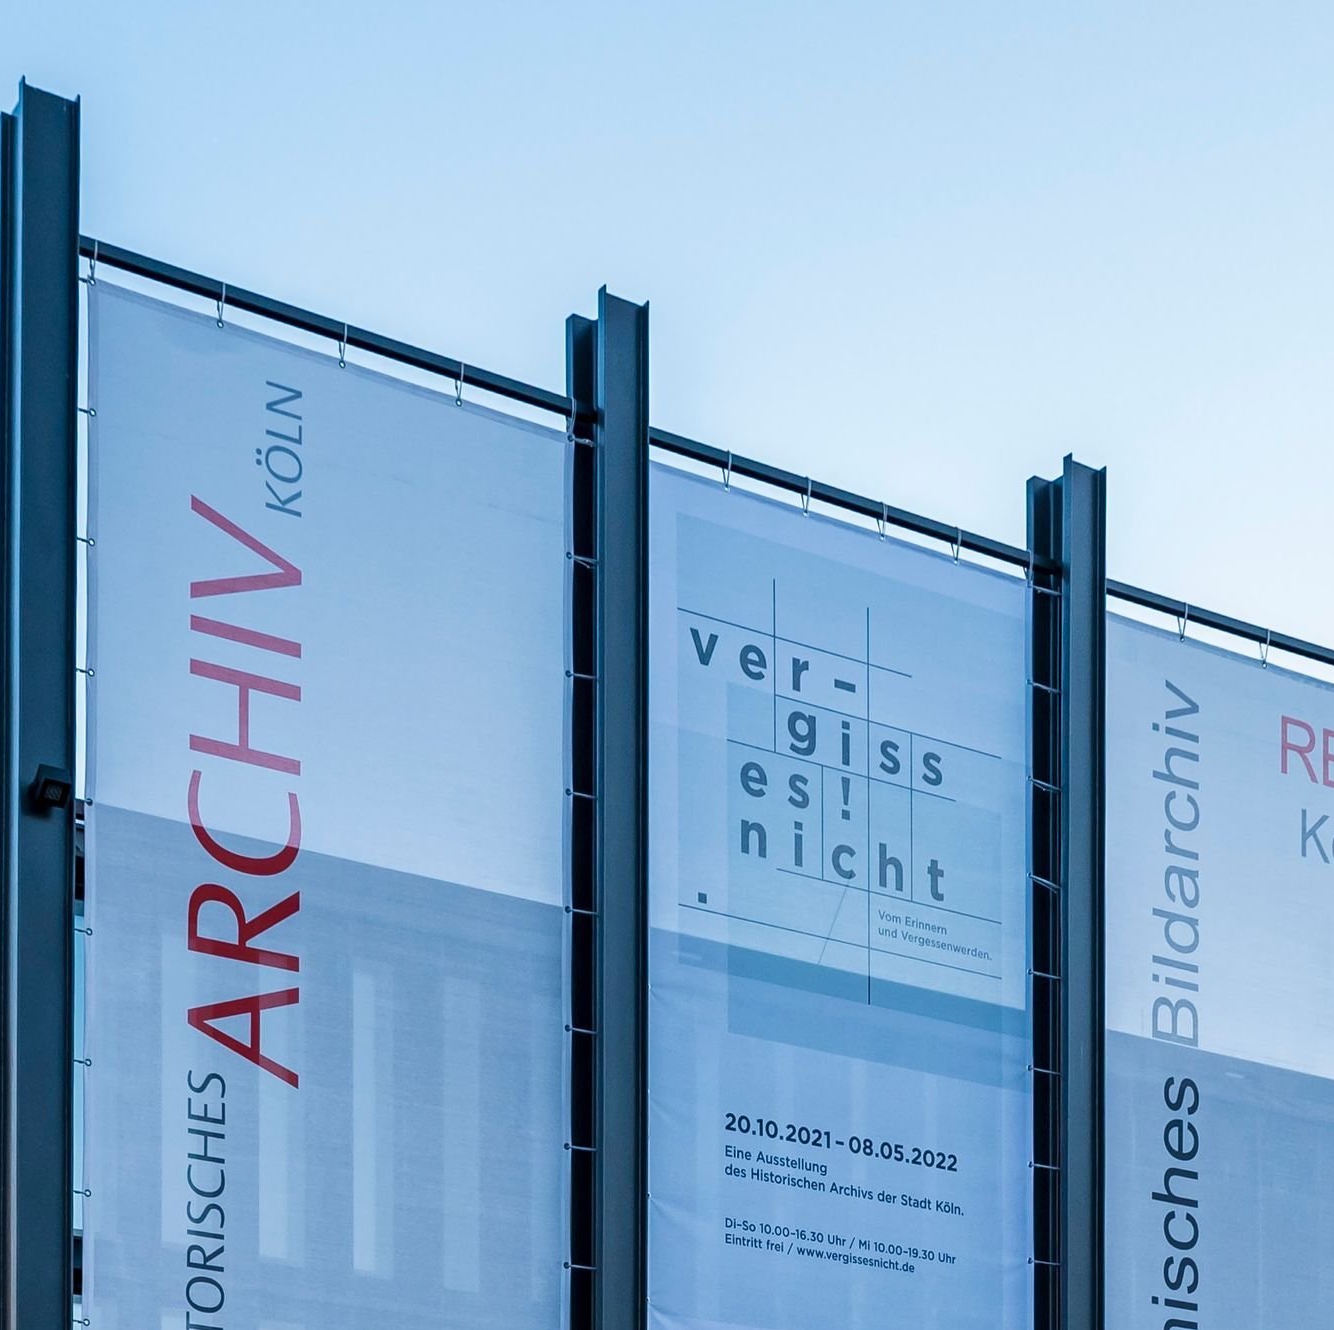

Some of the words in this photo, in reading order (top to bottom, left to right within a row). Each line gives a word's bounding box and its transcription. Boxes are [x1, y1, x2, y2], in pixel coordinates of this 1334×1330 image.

[188, 494, 303, 1090] ARCHIV
[255, 379, 303, 518] KÖLN
[787, 709, 944, 787] giss
[740, 760, 851, 821] es!
[740, 818, 945, 902] nicht
[1151, 679, 1201, 1049] Bildarchiv
[878, 909, 902, 925] Vom
[905, 916, 948, 936] Erinnern
[878, 927, 898, 939] und
[901, 930, 993, 961] Vergessenwerden.
[724, 1145, 752, 1161] Eine
[756, 1152, 828, 1176] Ausstellung
[724, 1163, 747, 1178] des
[750, 1167, 825, 1192] Historischen
[829, 1181, 874, 1200] Archivs
[877, 1189, 897, 1204] der
[901, 1194, 932, 1210] Stadt
[935, 1200, 965, 1216] Köln.
[725, 1233, 763, 1249] Eintritt
[766, 1239, 784, 1253] frei
[796, 1245, 916, 1274] www.vergissesnicht.de
[827, 1233, 847, 1247] Uhr
[858, 1239, 871, 1251] Mi
[938, 1252, 957, 1265] Uhr
